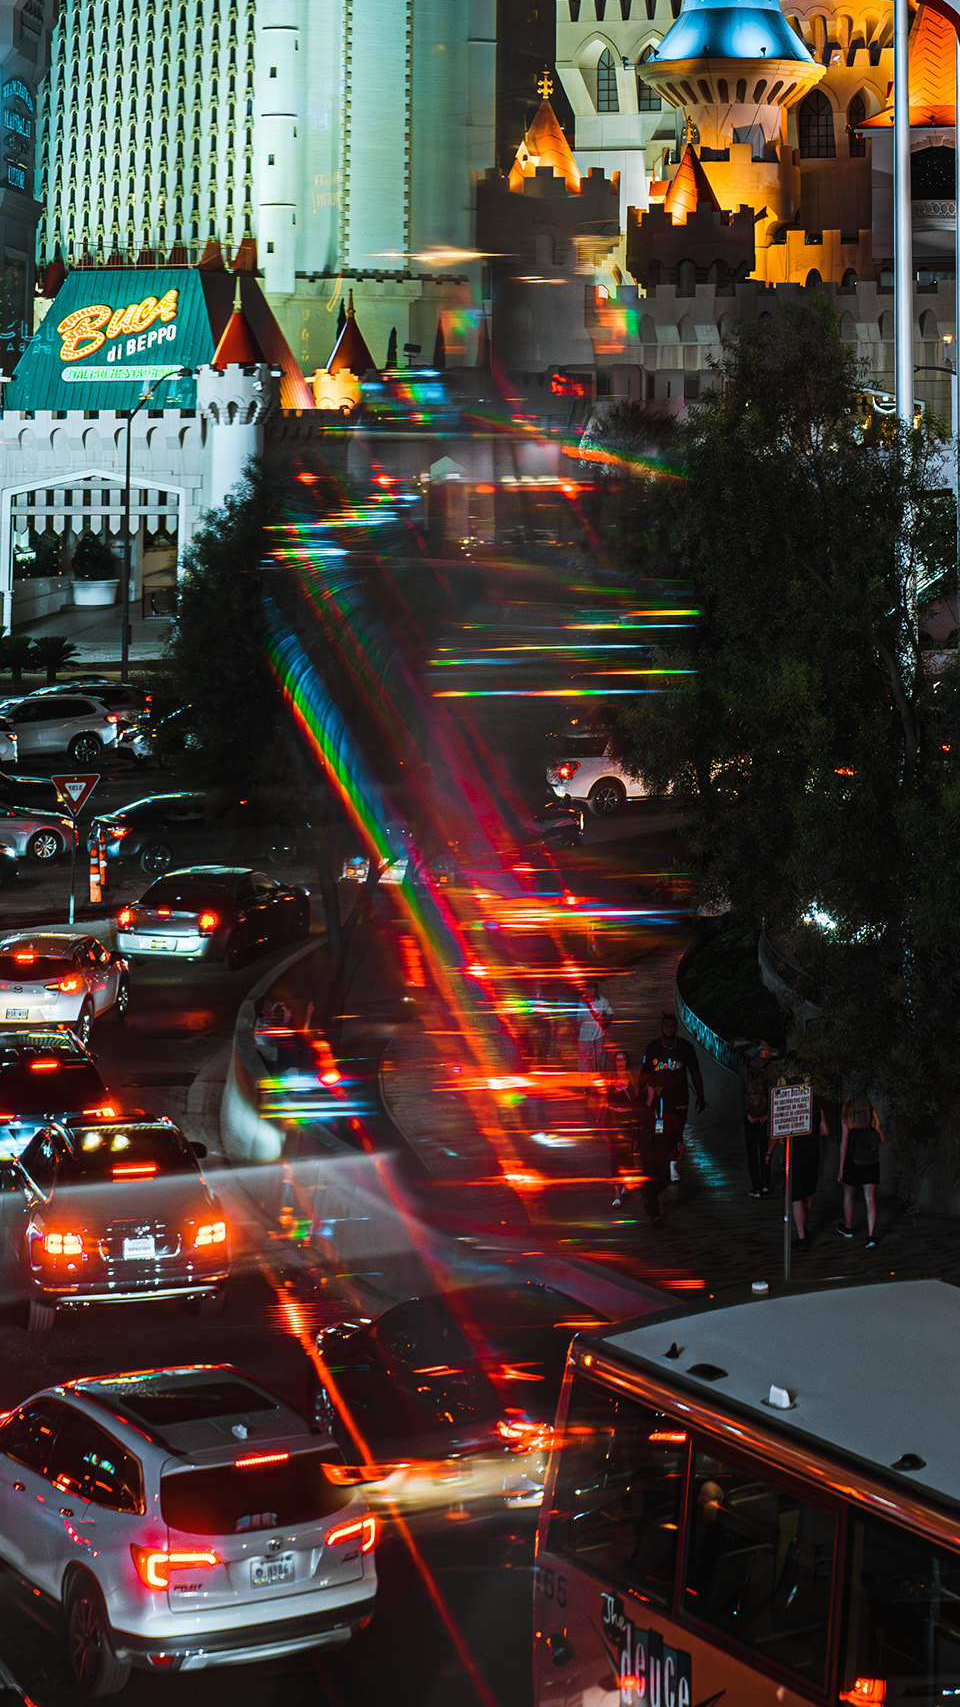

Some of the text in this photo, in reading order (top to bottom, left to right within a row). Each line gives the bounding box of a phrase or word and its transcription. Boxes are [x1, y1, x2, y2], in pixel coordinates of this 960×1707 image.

[107, 324, 177, 362] di BEPPO
[67, 368, 107, 379] ITALIAN
[600, 1592, 629, 1632] The
[620, 1624, 691, 1707] deuce
